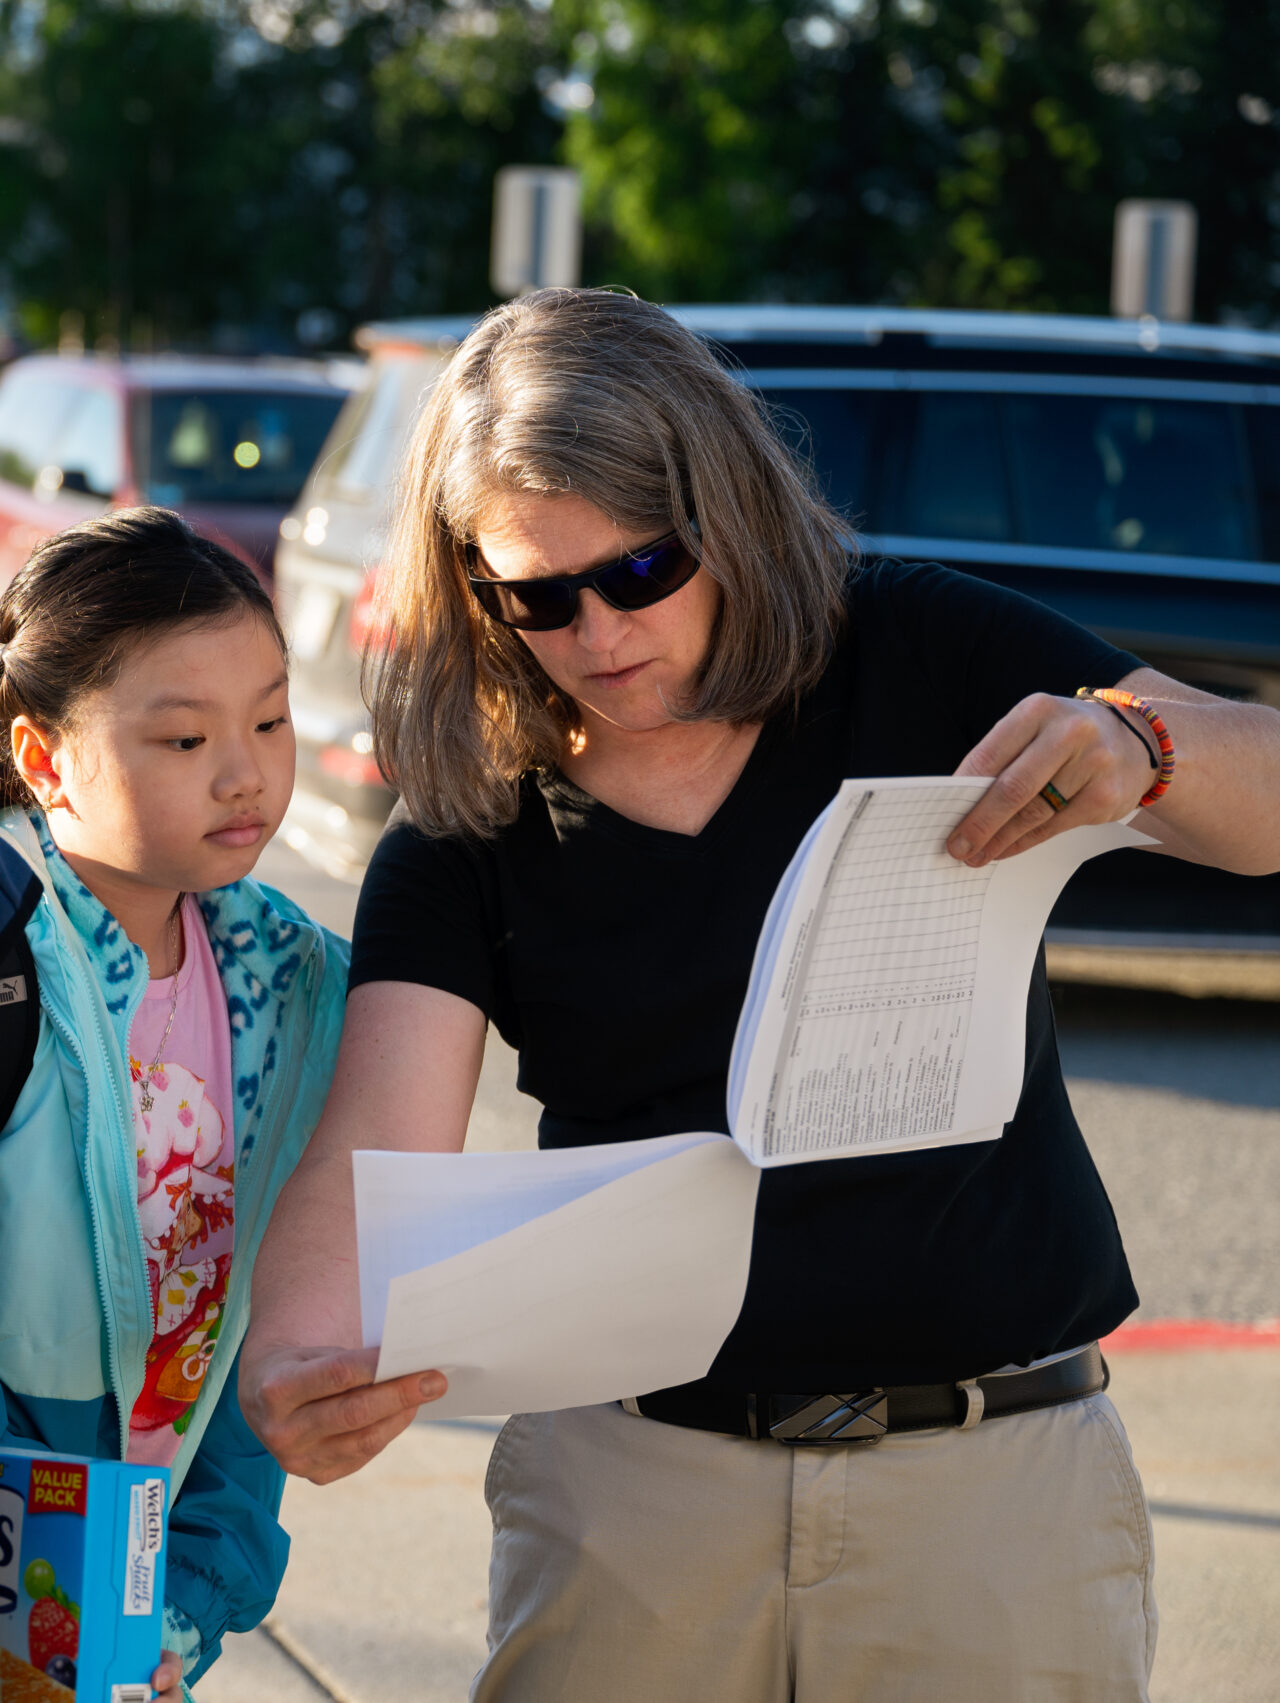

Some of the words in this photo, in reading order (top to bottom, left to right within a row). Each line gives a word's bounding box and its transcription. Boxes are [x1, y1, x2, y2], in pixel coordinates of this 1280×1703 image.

[31, 1468, 83, 1490] VALUE
[34, 1487, 76, 1507] PACK
[146, 1484, 161, 1550] Welch's
